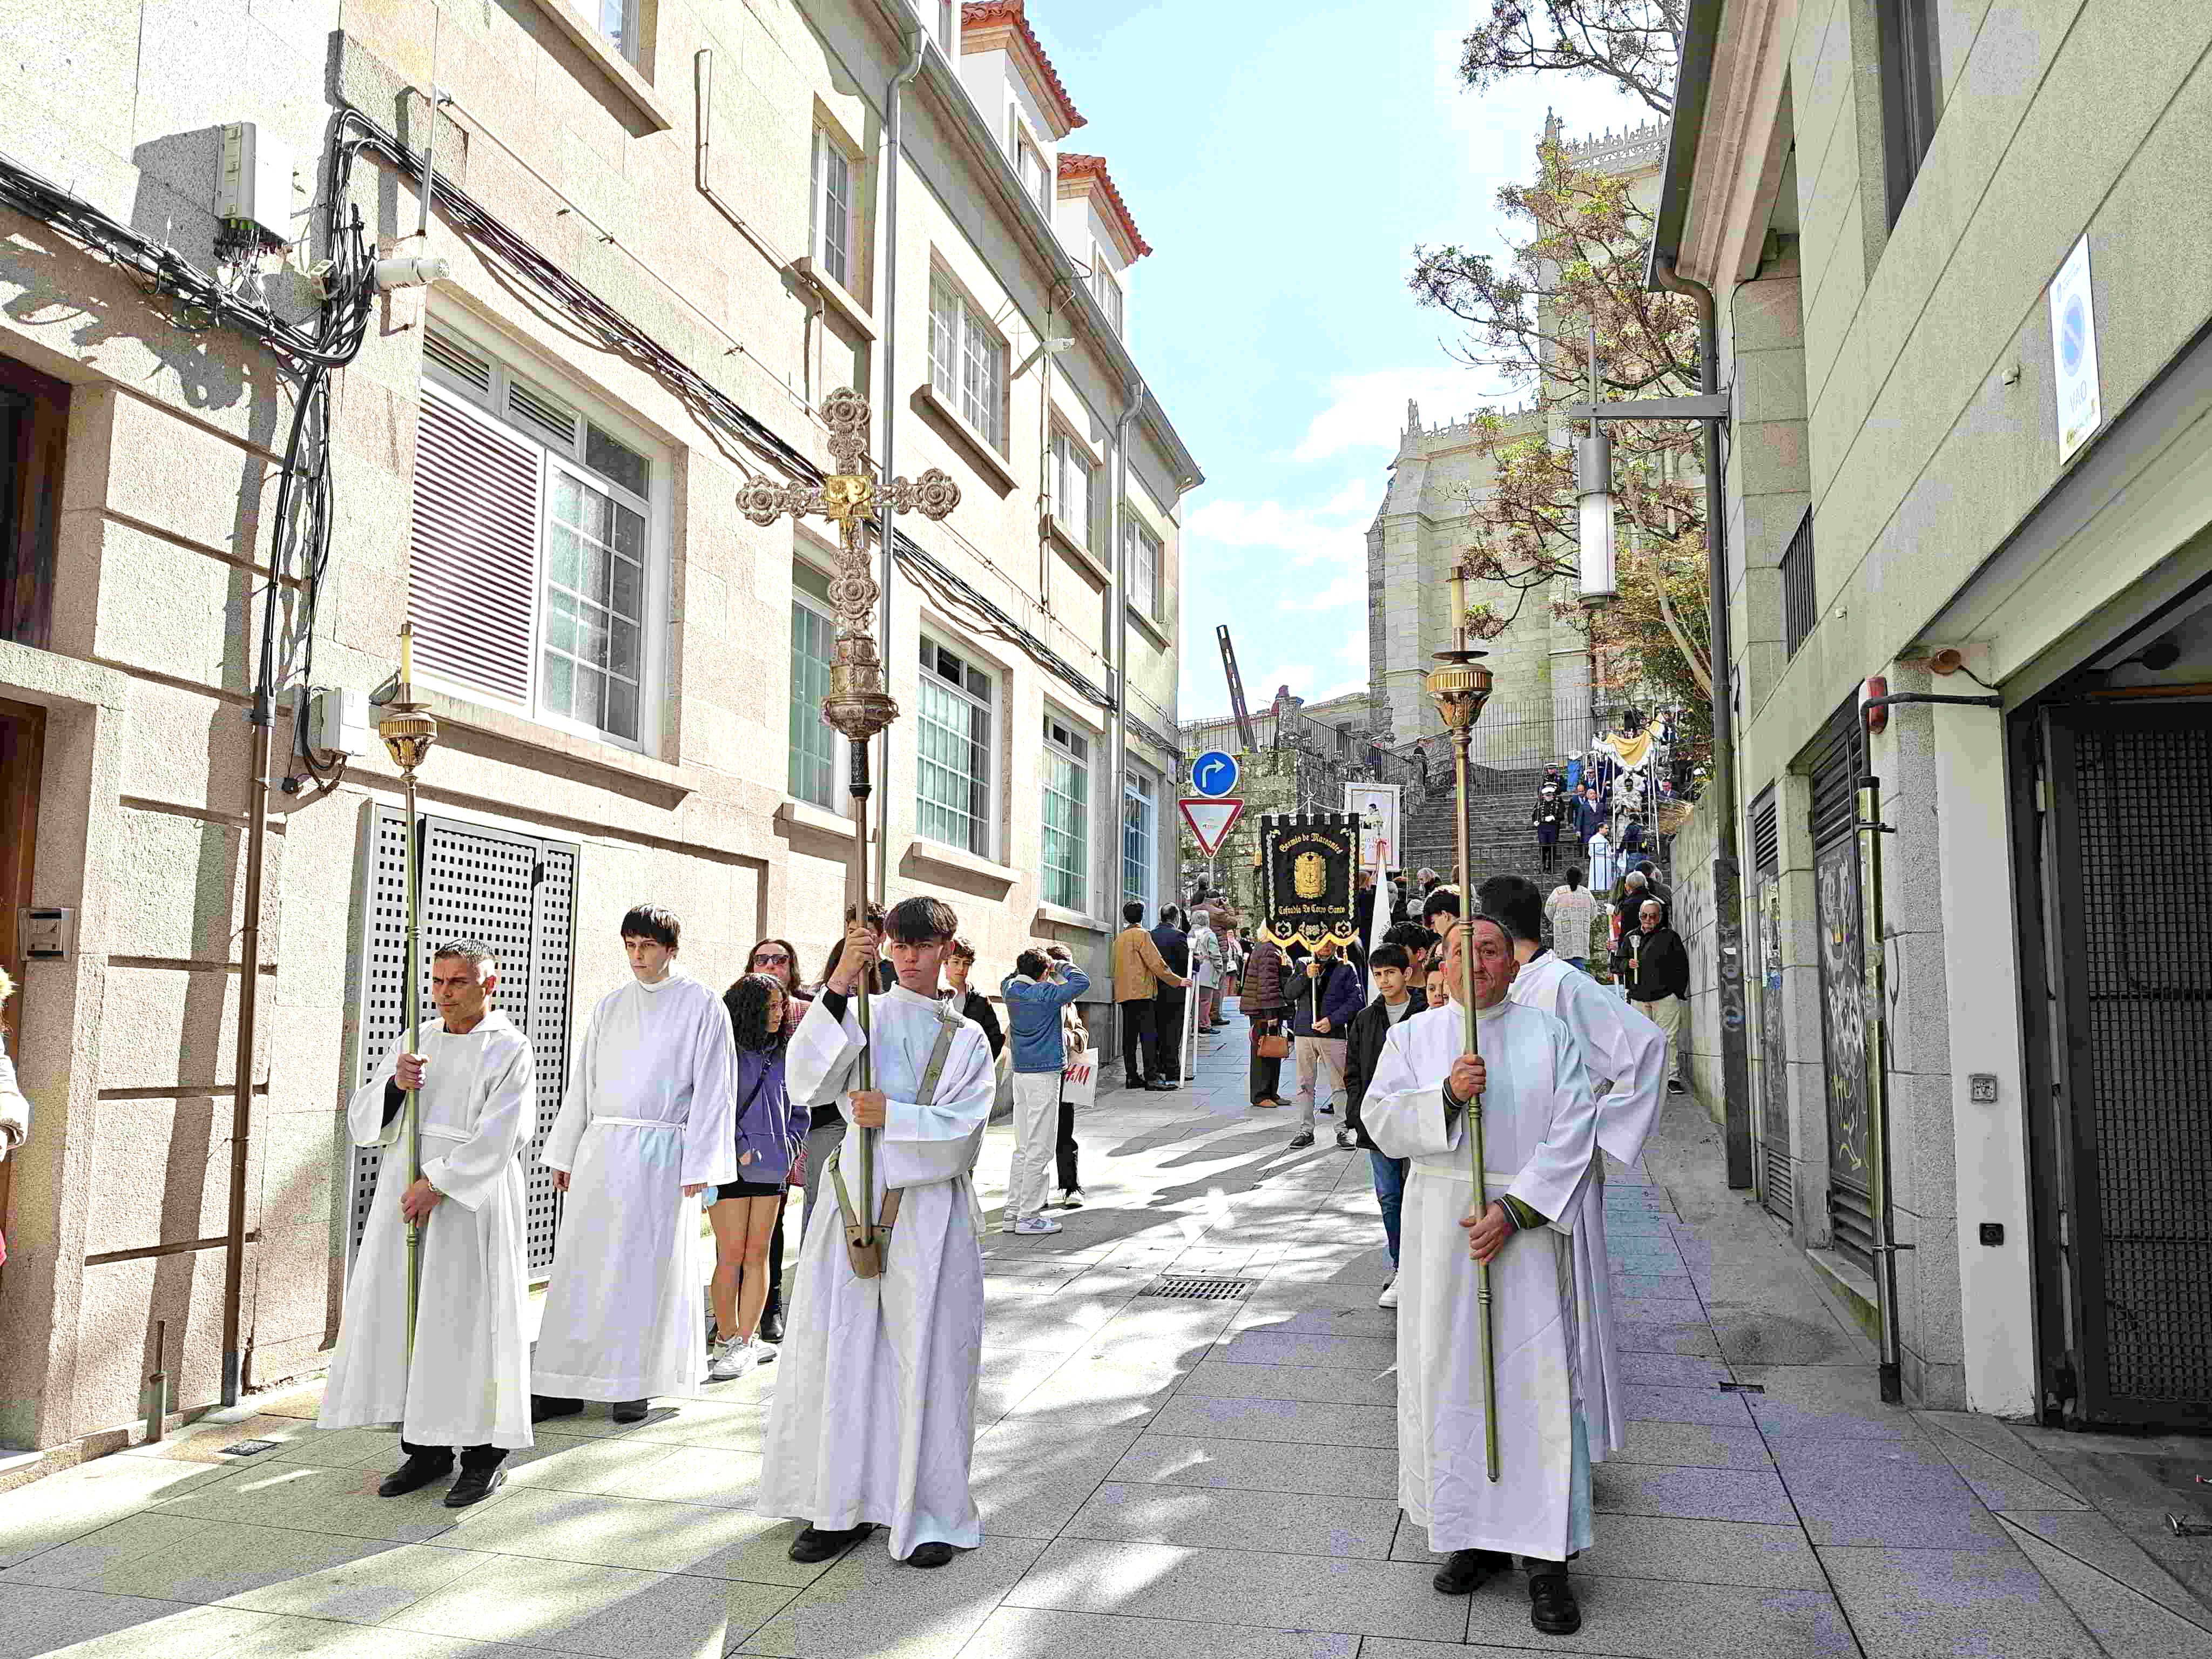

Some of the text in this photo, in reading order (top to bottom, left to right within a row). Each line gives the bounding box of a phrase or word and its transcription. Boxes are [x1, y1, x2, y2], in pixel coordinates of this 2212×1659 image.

[1279, 833, 1344, 854] Gremio de Mareantes
[1327, 905, 1345, 913] Santo
